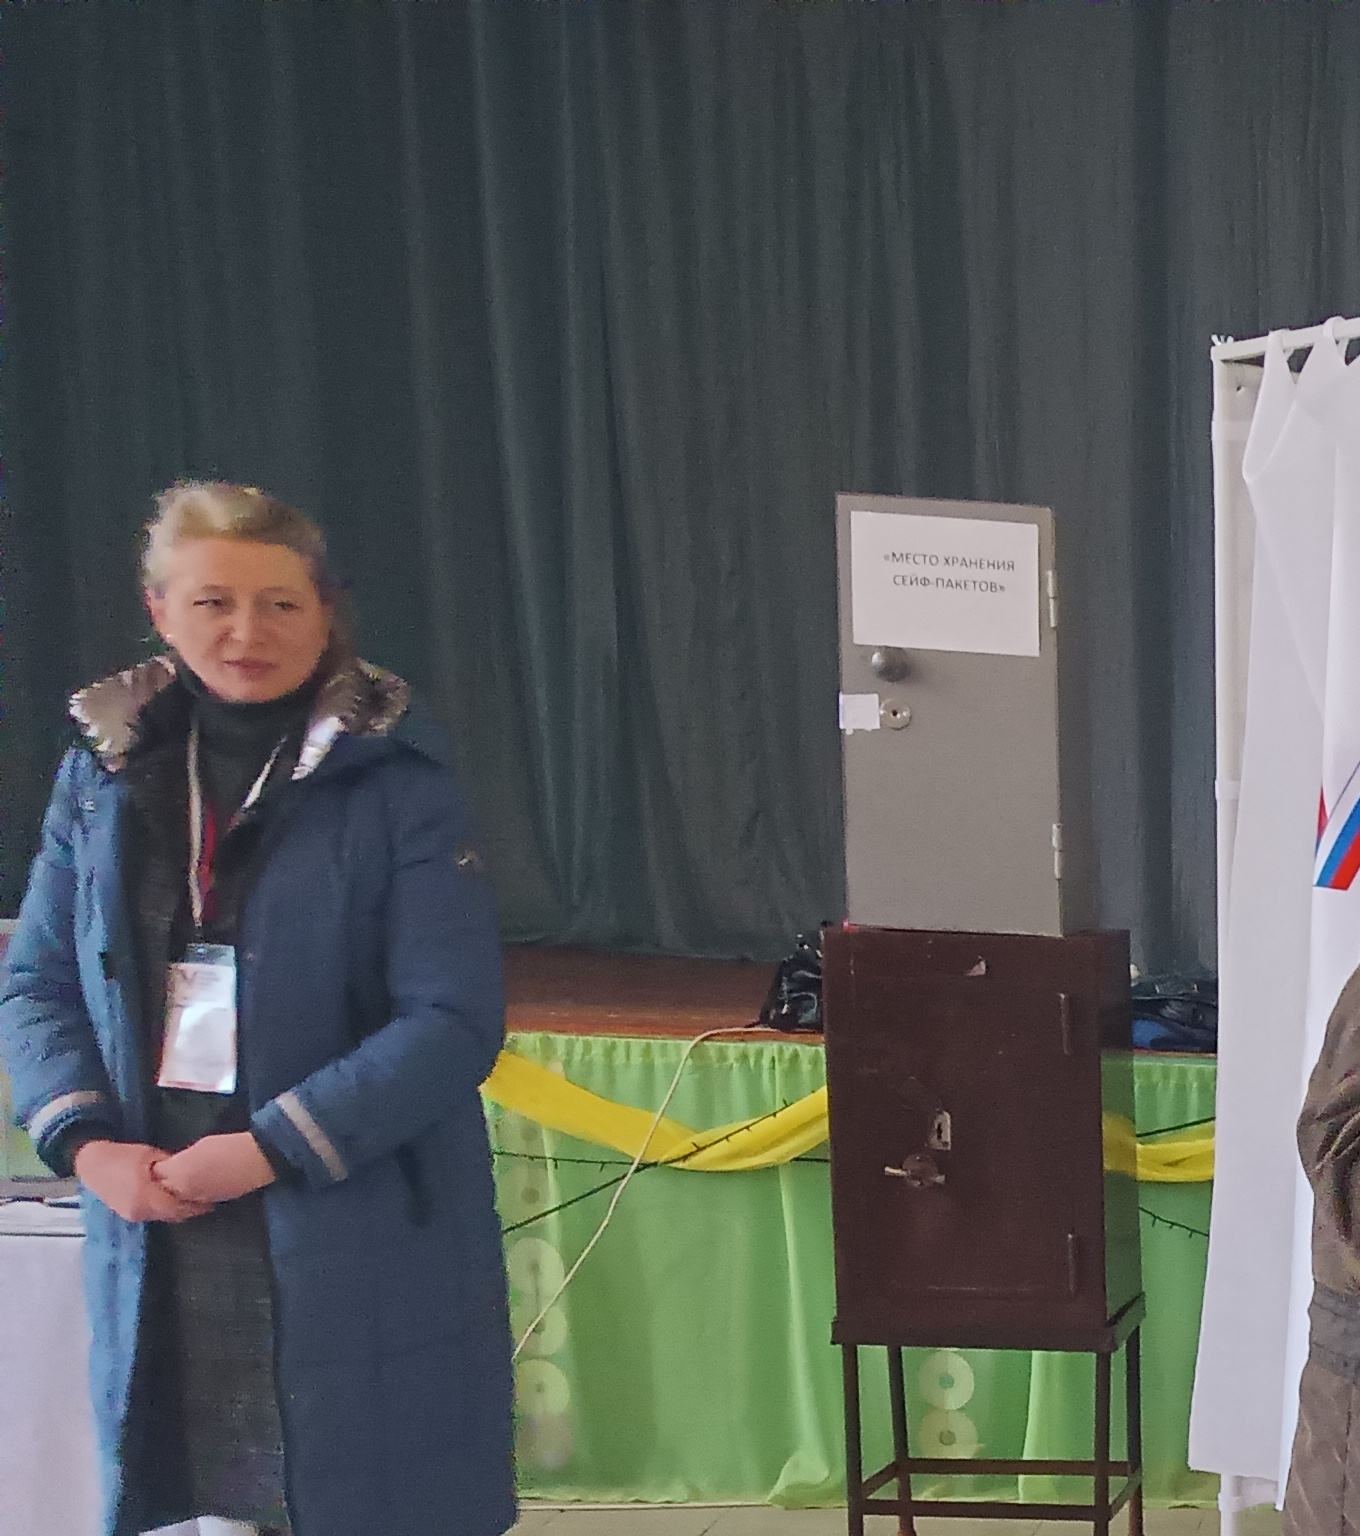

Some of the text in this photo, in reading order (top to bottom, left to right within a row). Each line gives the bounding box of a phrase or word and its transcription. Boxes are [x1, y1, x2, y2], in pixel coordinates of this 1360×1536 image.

[884, 551, 1015, 571] «МЕСТО ХРАНЕНИЯ
[892, 572, 1006, 593] СЕЙФ-ПАКЕТОВ»
